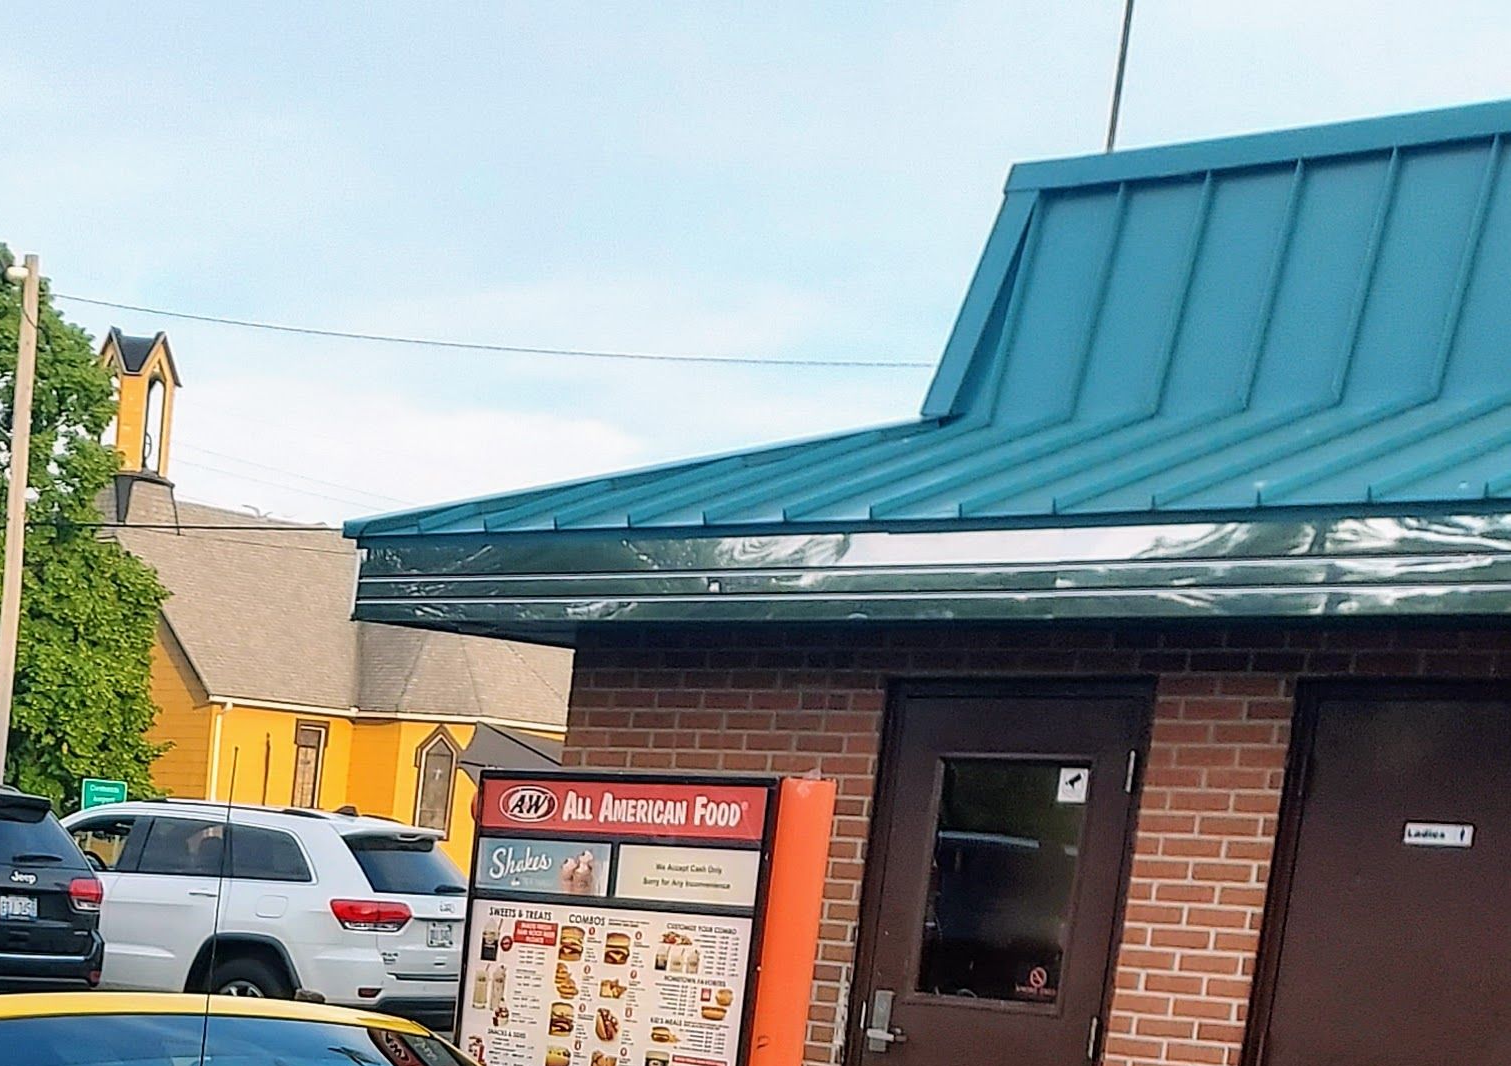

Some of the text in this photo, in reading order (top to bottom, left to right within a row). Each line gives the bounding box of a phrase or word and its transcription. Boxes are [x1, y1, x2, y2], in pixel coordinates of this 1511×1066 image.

[562, 790, 593, 822] ALL
[598, 792, 687, 826] AMERICAN
[693, 796, 741, 827] FOOD
[1408, 827, 1445, 839] Ladies
[490, 846, 552, 879] Shakes
[667, 864, 689, 873] Accept
[690, 865, 706, 873] Cash
[708, 866, 722, 875] Only
[10, 871, 37, 885] Jeep
[643, 877, 659, 887] Sorry
[671, 880, 684, 888] Any
[489, 907, 516, 918] SWEETS
[525, 910, 552, 921] TREATS
[569, 914, 605, 926] COMBOS
